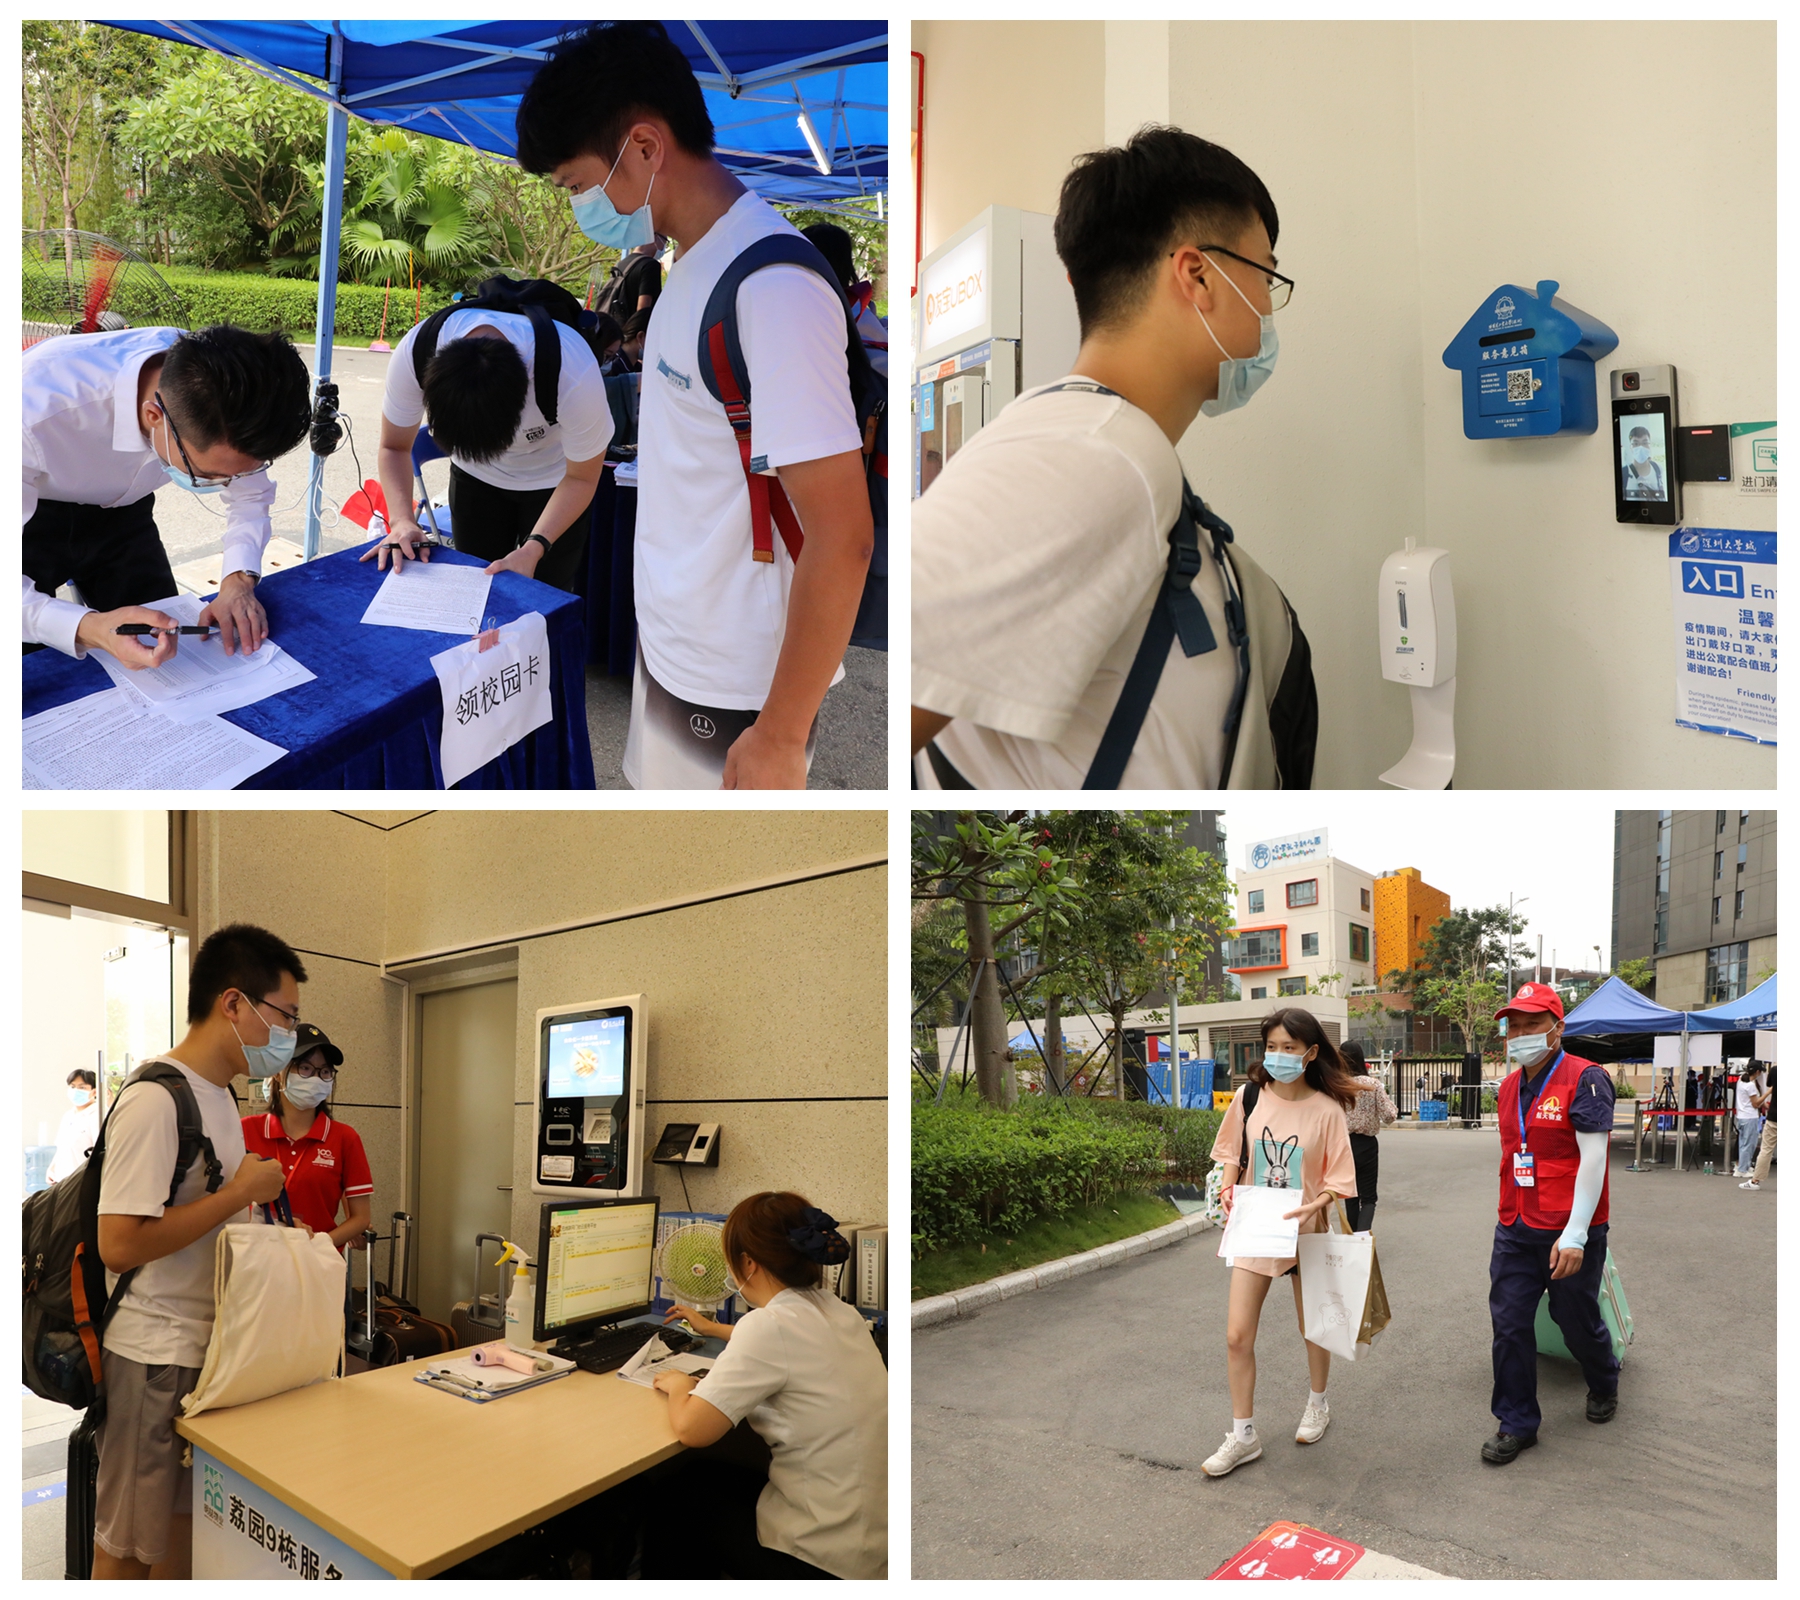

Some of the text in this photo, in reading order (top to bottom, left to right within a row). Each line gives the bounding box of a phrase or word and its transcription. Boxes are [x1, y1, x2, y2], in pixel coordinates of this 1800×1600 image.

[1482, 344, 1528, 360] 服务意见箱
[1688, 566, 1738, 594] 入口
[1751, 584, 1777, 600] En
[1738, 608, 1775, 628] 温馨
[1684, 622, 1777, 645] 疫情期间，请大家
[455, 655, 540, 726] 领校园卡
[1688, 689, 1706, 698] During
[1737, 688, 1777, 704] Friendly
